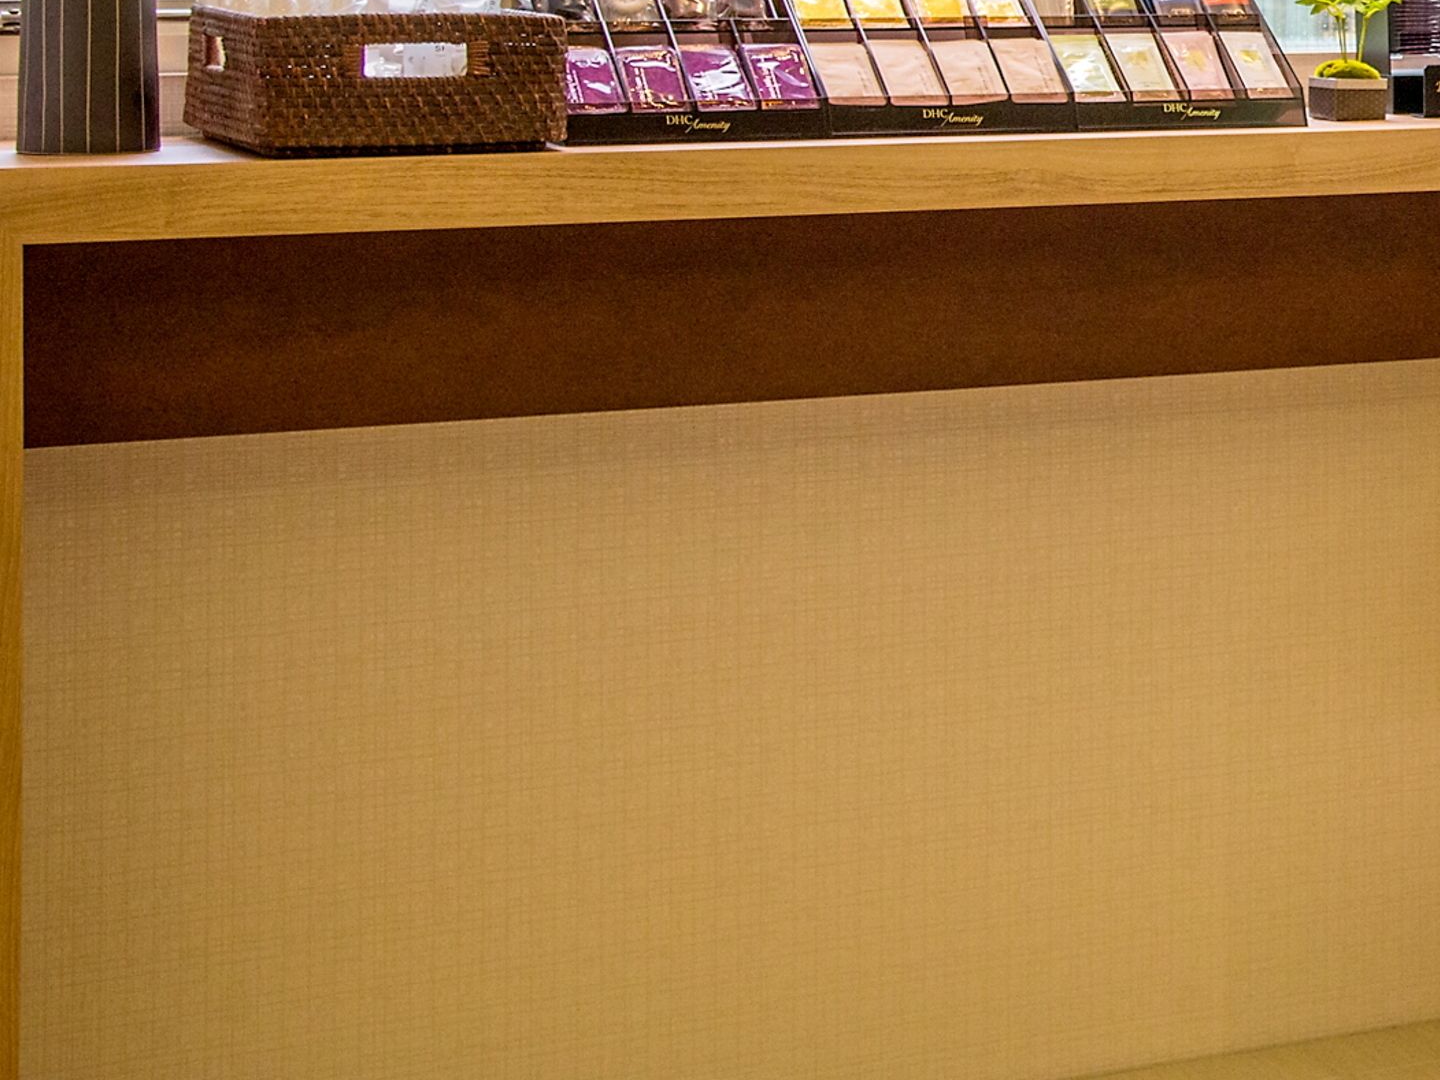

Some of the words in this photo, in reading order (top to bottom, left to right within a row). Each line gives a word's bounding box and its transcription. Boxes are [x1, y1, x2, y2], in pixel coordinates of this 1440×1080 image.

[1163, 102, 1187, 113] DHC
[922, 108, 948, 119] DHC
[666, 115, 693, 125] DHC
